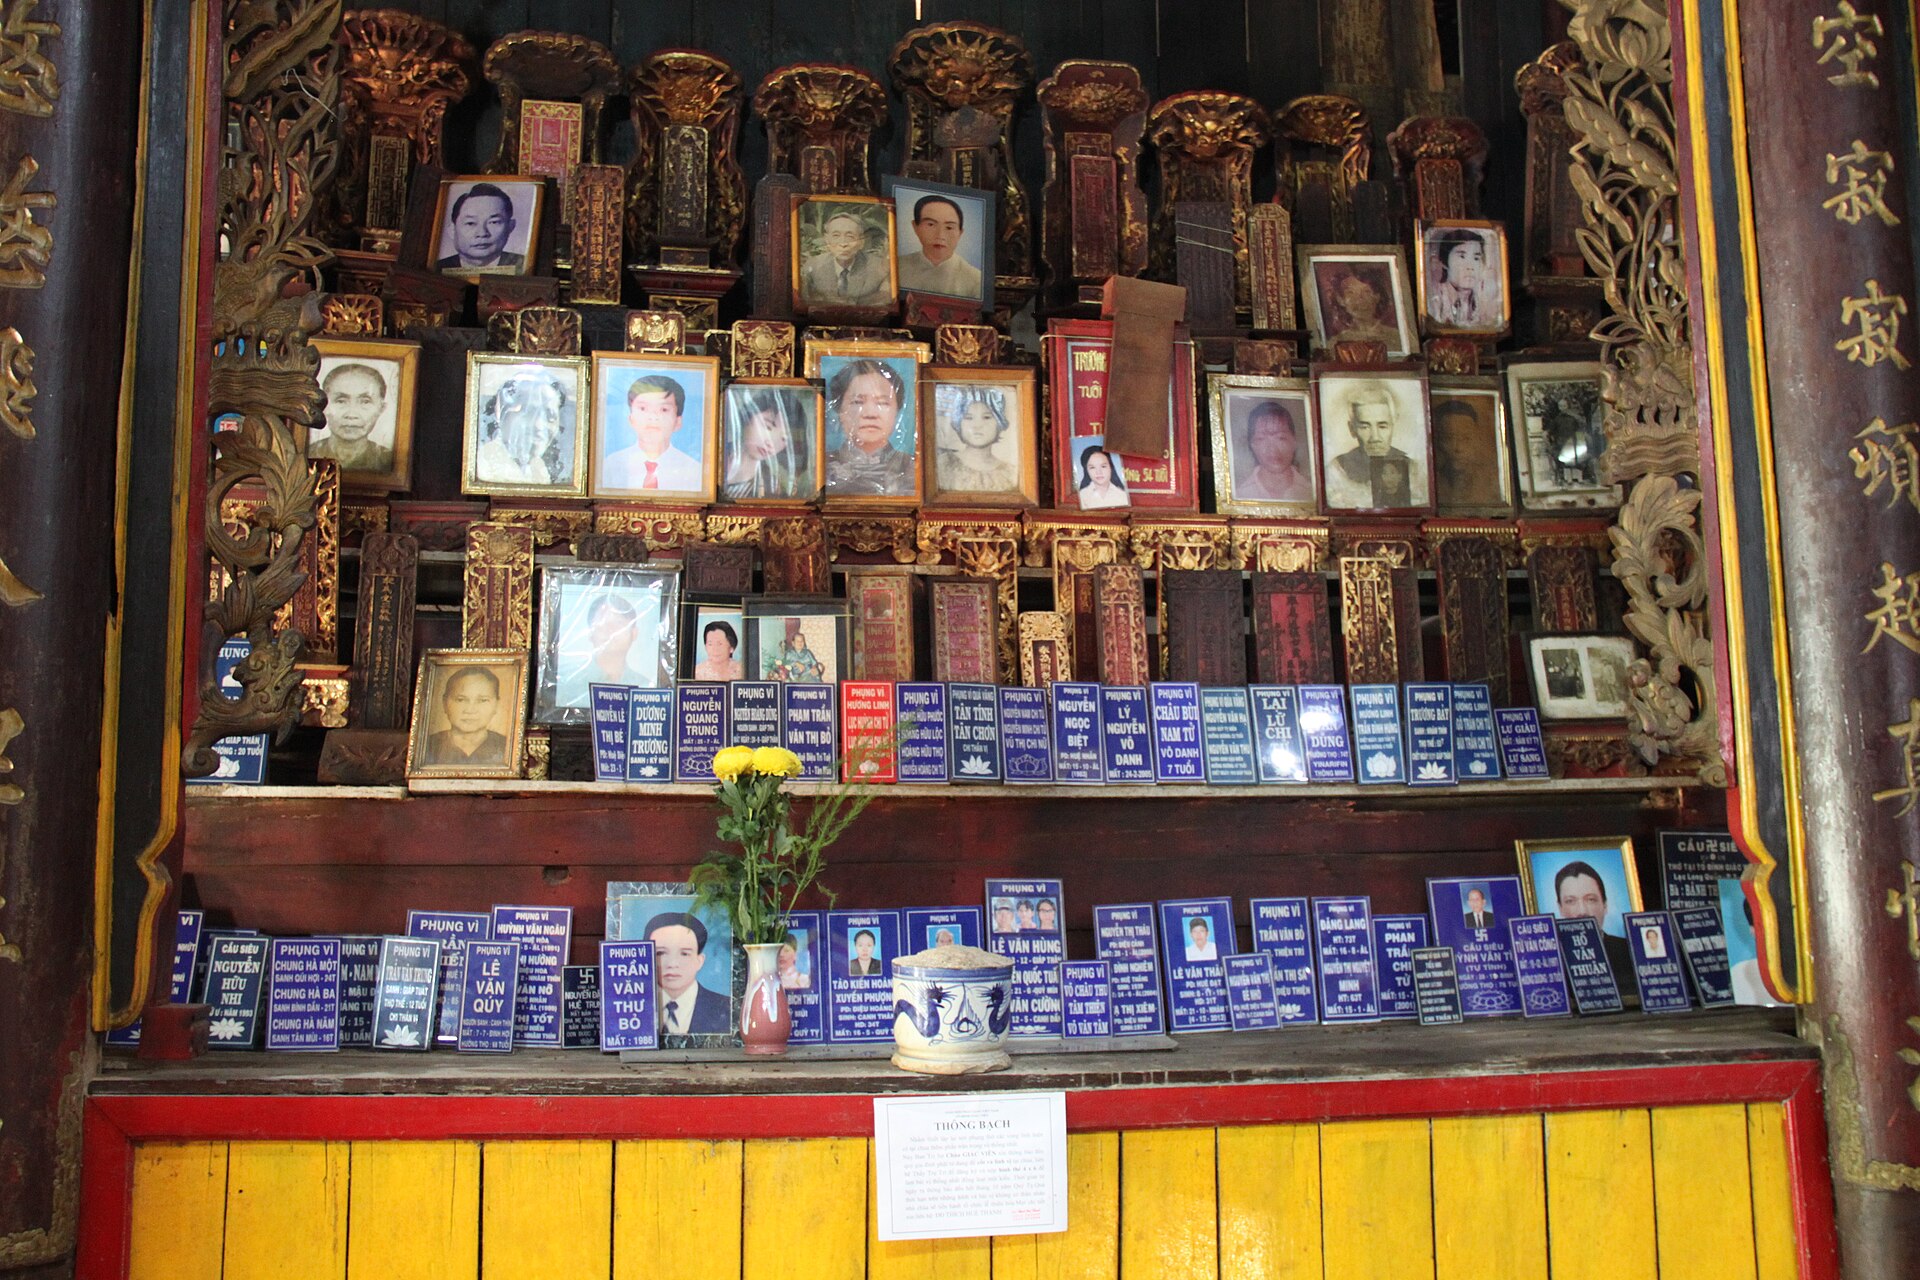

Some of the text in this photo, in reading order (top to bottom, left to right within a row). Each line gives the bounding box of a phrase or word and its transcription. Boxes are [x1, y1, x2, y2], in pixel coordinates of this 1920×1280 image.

[599, 691, 624, 703] PHỤNG
[686, 689, 709, 698] PHỤNG
[738, 685, 774, 701] PHỤNG VÌ
[792, 690, 827, 701] PHỤNG VÌ
[851, 687, 884, 699] PHỤNG VÌ
[904, 689, 938, 707] PHỤNG VÌ
[1005, 691, 1042, 704] PHỤNG VÌ
[1063, 687, 1082, 696] PHỤNG
[1105, 691, 1141, 703] PHỤNG VÌ
[1157, 687, 1192, 701] PHỤNG VÌ
[1305, 691, 1331, 702] PHỤNG
[1414, 692, 1433, 704] PHỤNG
[633, 694, 661, 704] PHỤNG
[682, 697, 721, 713] NGUYỄN
[1058, 696, 1095, 713] NGUYỄN
[1262, 698, 1287, 713] LẠI
[1356, 690, 1394, 708] PHỤNG VÌ
[636, 706, 666, 721] DƯƠNG
[873, 702, 890, 711] LINH
[1118, 705, 1131, 719] LÝ
[1155, 702, 1199, 721] CHÂU BÙI
[685, 713, 719, 725] QUANG
[788, 704, 831, 724] PHẠM TRẦN
[1502, 713, 1523, 723] PHỤNG
[639, 722, 663, 737] MINH
[686, 725, 718, 738] TRUNG
[1064, 717, 1091, 732] NGỌC
[1106, 718, 1146, 734] NGUYỄN
[601, 730, 614, 746] THỊ
[789, 729, 805, 744] VĂN
[805, 731, 819, 748] THỊ
[1161, 727, 1181, 742] NAM
[1265, 727, 1292, 739] CHI
[1016, 739, 1037, 751] THỊ CHI
[1067, 733, 1088, 749] BIỆT
[1120, 736, 1134, 750] VÔ
[1161, 746, 1199, 758] VÔ DANH
[1520, 752, 1540, 763] SANG
[630, 757, 648, 765] SANH
[1115, 754, 1142, 766] DANH
[1167, 759, 1195, 774] 7 TUỔI
[1002, 883, 1046, 894] PHỤNG VÌ
[516, 911, 549, 922] PHỤNG VÌ
[1111, 911, 1130, 922] PHỤNG
[1183, 907, 1201, 916] PHỤNG
[1260, 903, 1301, 920] PHỤNG VÌ
[1328, 906, 1346, 914] PHỤNG
[420, 920, 479, 933] PHỤNG VÌ
[497, 922, 543, 935] HUỲNH VĂN
[848, 916, 879, 927] PHỤNG VÌ
[1320, 917, 1366, 934] ĐẶNG LANG
[1385, 932, 1415, 943] PHAN
[280, 942, 334, 958] PHỤNG VÌ
[368, 942, 378, 956] VÌ
[393, 945, 431, 959] PHỤNG VÌ
[476, 945, 510, 957] PHỤNG VÌ
[992, 936, 1061, 954] LÊ VĂN HÙNG
[609, 946, 646, 960] PHỤNG VÌ
[1480, 951, 1498, 962] VĂN
[1573, 946, 1595, 961] VĂN
[213, 956, 261, 974] NGUYỄN
[275, 957, 338, 973] CHUNG HÀ MỘT
[482, 959, 501, 976] LÊ
[607, 959, 649, 976] TRẦN
[1392, 962, 1412, 972] CHI
[275, 974, 293, 983] SANH
[1023, 966, 1043, 986] QUỐC
[1066, 964, 1104, 982] PHỤNG VÌ
[1173, 965, 1204, 980] LÊ VĂN
[221, 976, 247, 991] HỮU
[476, 978, 505, 995] VĂN
[613, 980, 645, 995] VĂN
[832, 977, 849, 990] TÀO
[1338, 979, 1360, 992] MINH
[221, 993, 243, 1006] NHI
[274, 986, 336, 1000] CHUNG HÀ BA
[273, 1004, 292, 1013] SANH
[613, 1000, 646, 1013] THƯ
[1010, 998, 1029, 1013] VĂN
[272, 1016, 335, 1030] CHUNG HÀ NĂM
[532, 1013, 554, 1024] TỐT
[271, 1034, 290, 1043] SANH
[607, 1034, 626, 1046] MẤT
[934, 1118, 1011, 1133] THÔNG BẠCH
